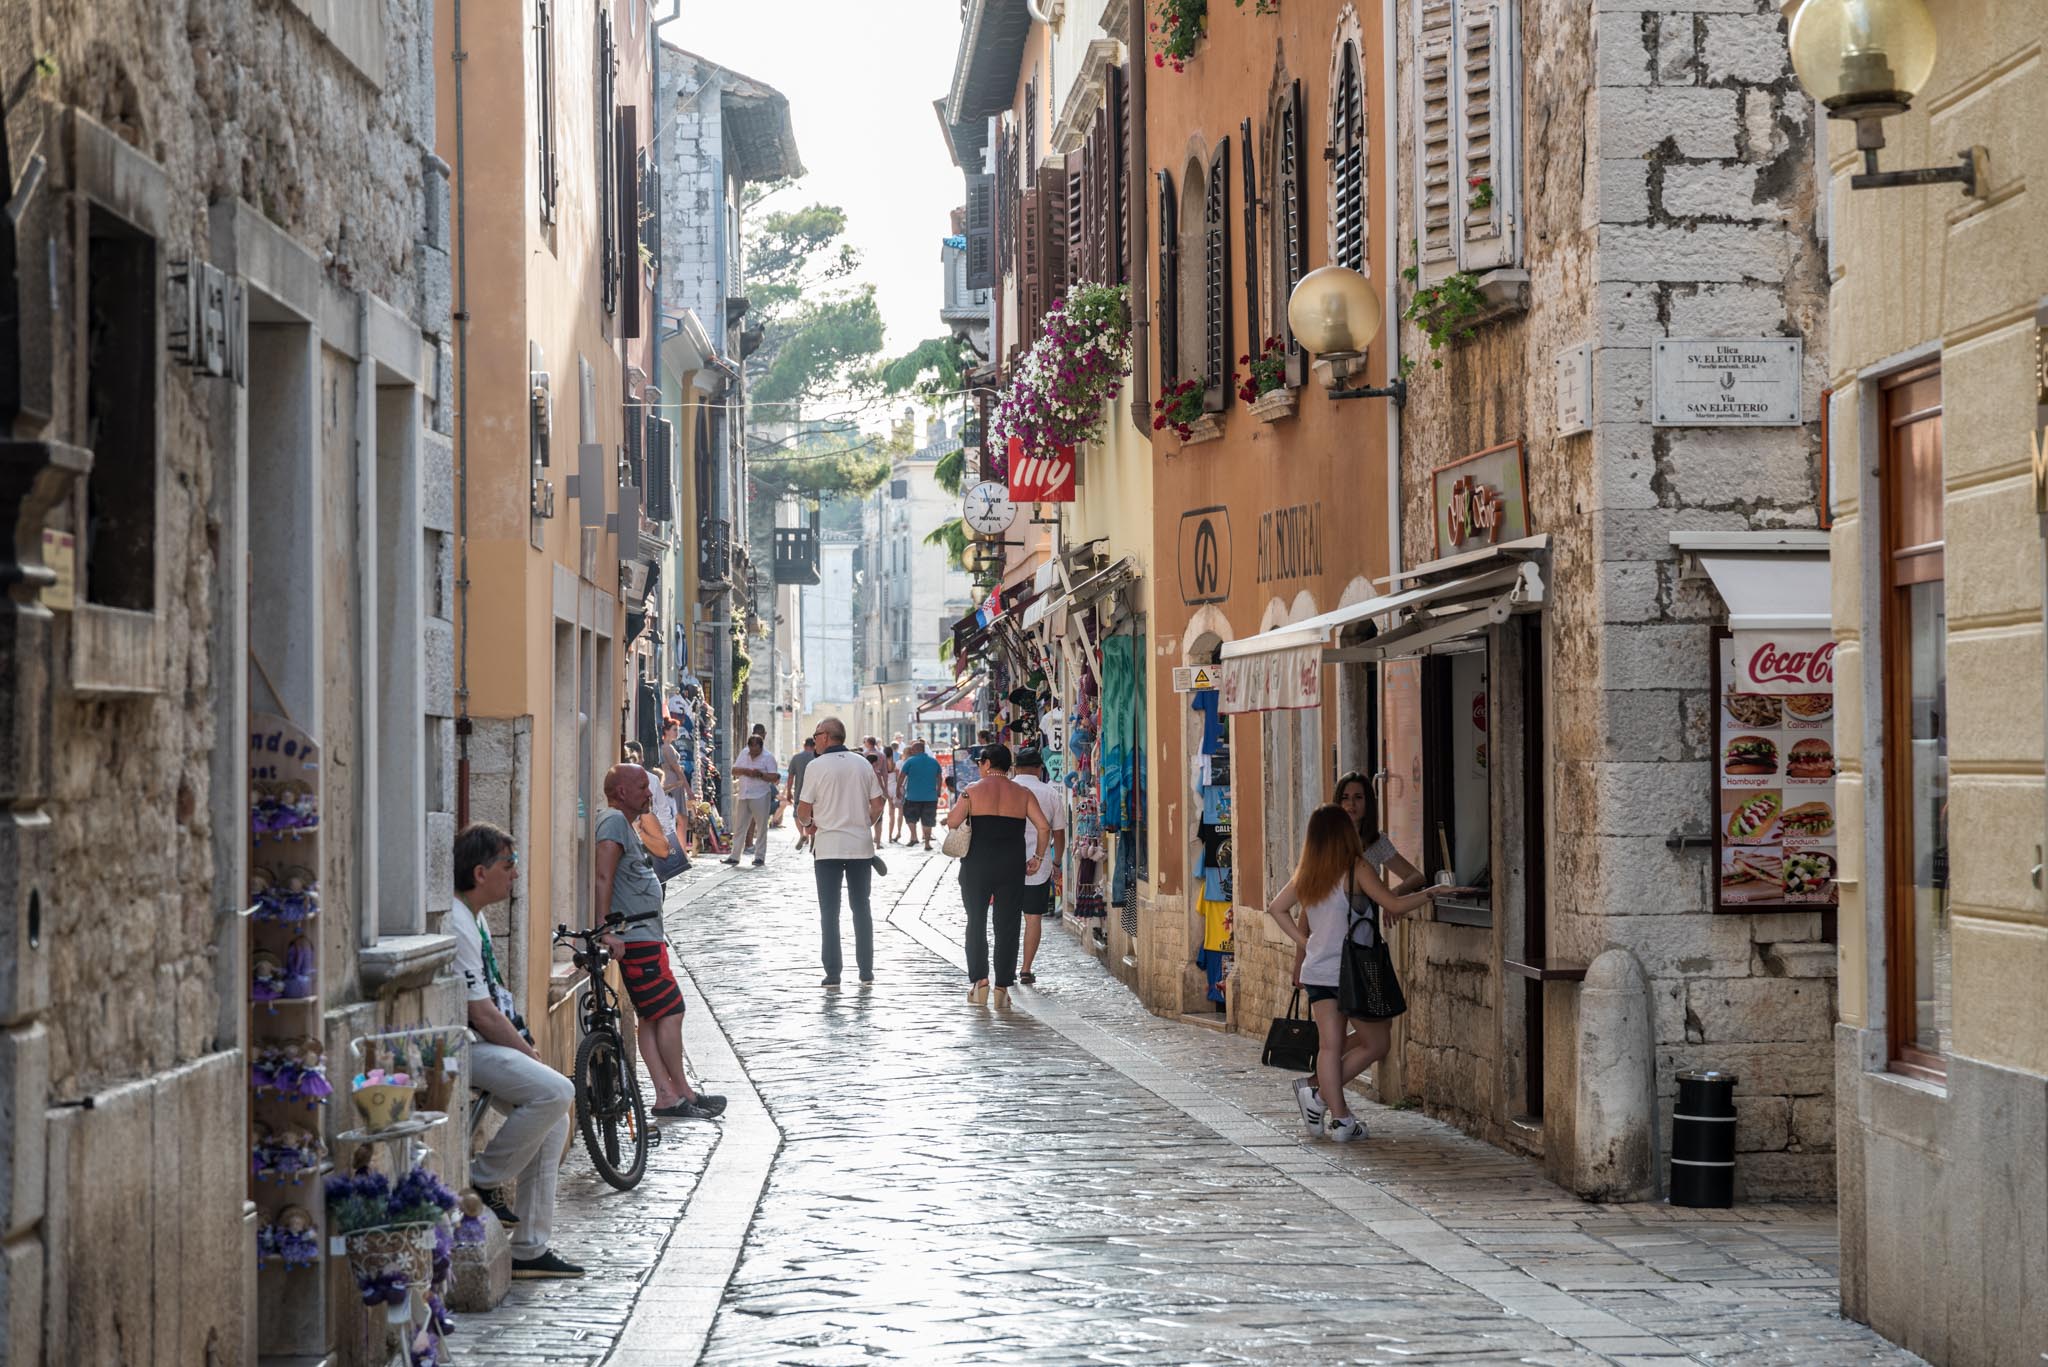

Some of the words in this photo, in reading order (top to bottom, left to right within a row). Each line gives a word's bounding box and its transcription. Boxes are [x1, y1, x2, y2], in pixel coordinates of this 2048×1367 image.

[1717, 346, 1739, 354] Ulica
[1688, 355, 1702, 363] SV.
[1704, 355, 1767, 363] ELEUTERIJA
[1721, 394, 1735, 402] Via
[1687, 403, 1707, 412] SAN
[1709, 403, 1769, 412] ELEUTERIO
[1256, 511, 1273, 584] ART
[1275, 501, 1323, 580] NOUVEAU
[1726, 777, 1769, 786] Hamburger
